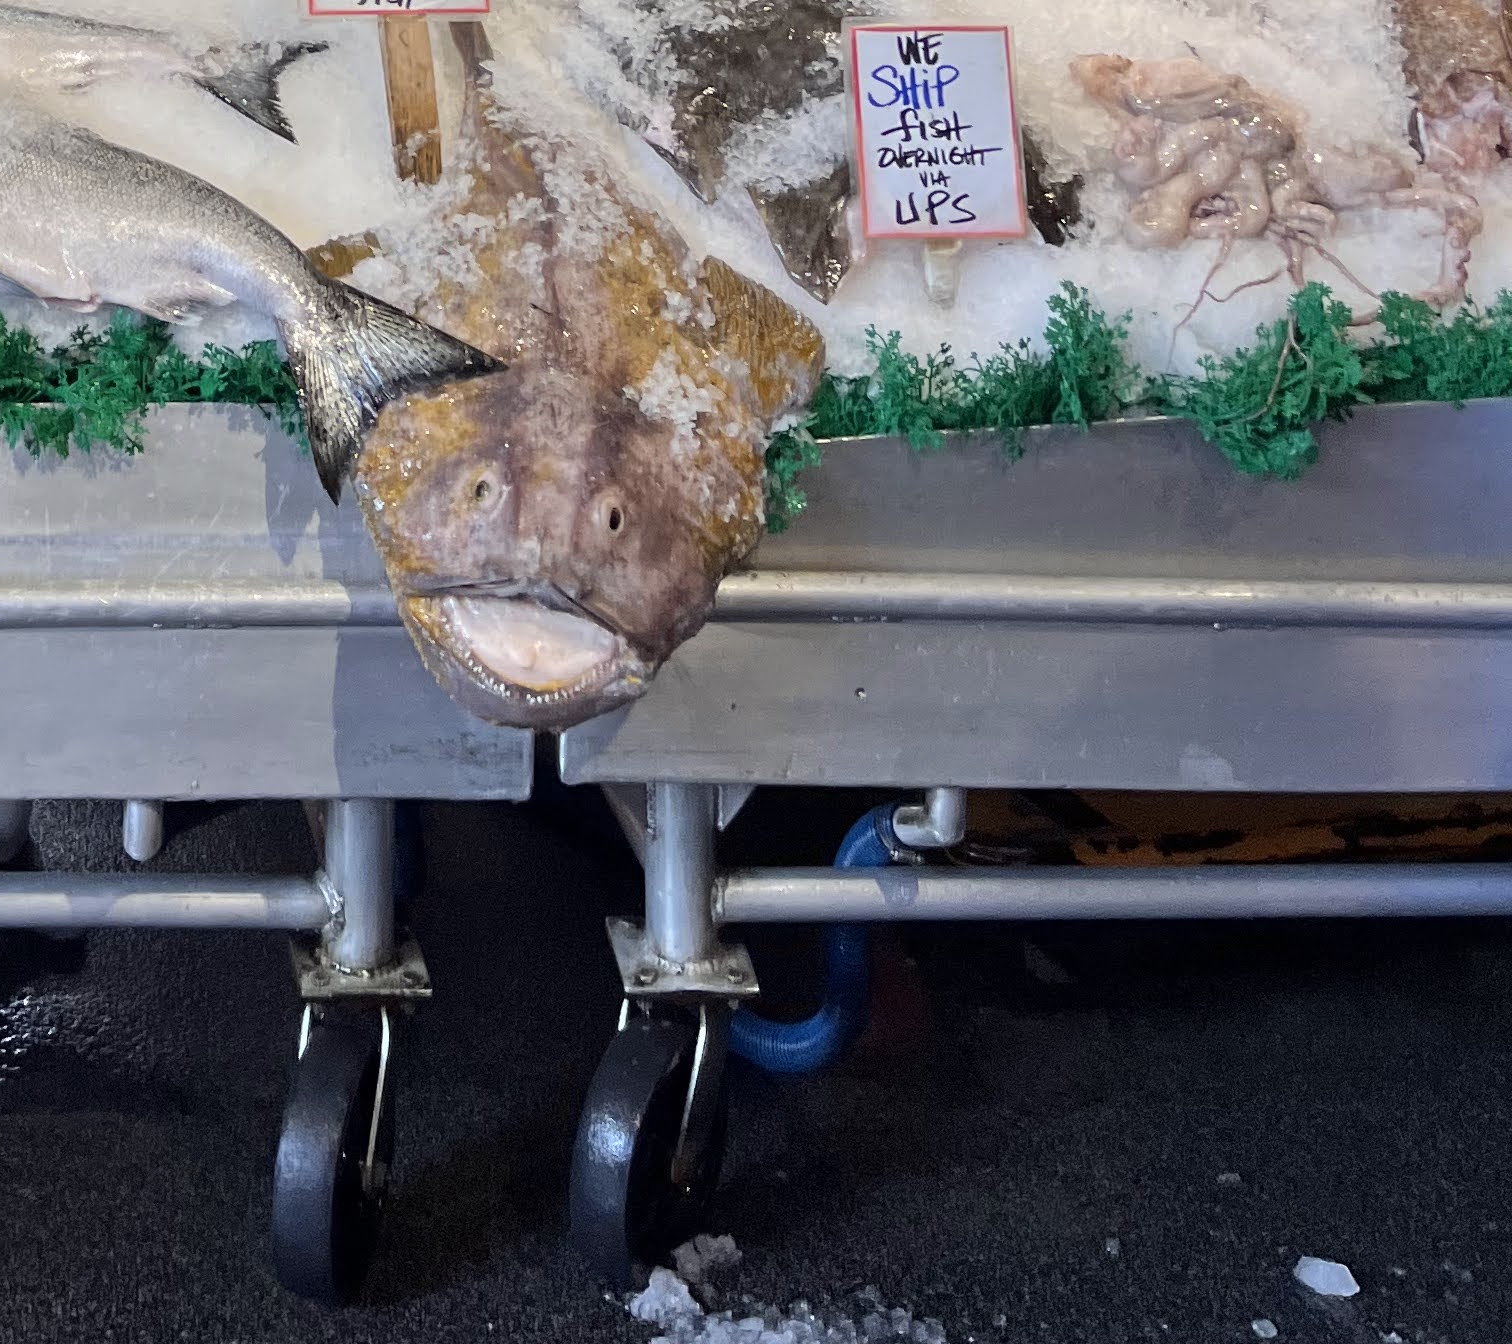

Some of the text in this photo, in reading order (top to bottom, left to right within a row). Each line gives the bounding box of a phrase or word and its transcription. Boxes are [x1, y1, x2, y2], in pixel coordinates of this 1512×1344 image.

[896, 29, 945, 66] WE
[867, 63, 961, 111] SHIP
[877, 143, 1004, 170] OVERNIGHT
[918, 169, 952, 189] VIA
[894, 189, 977, 227] UPS
